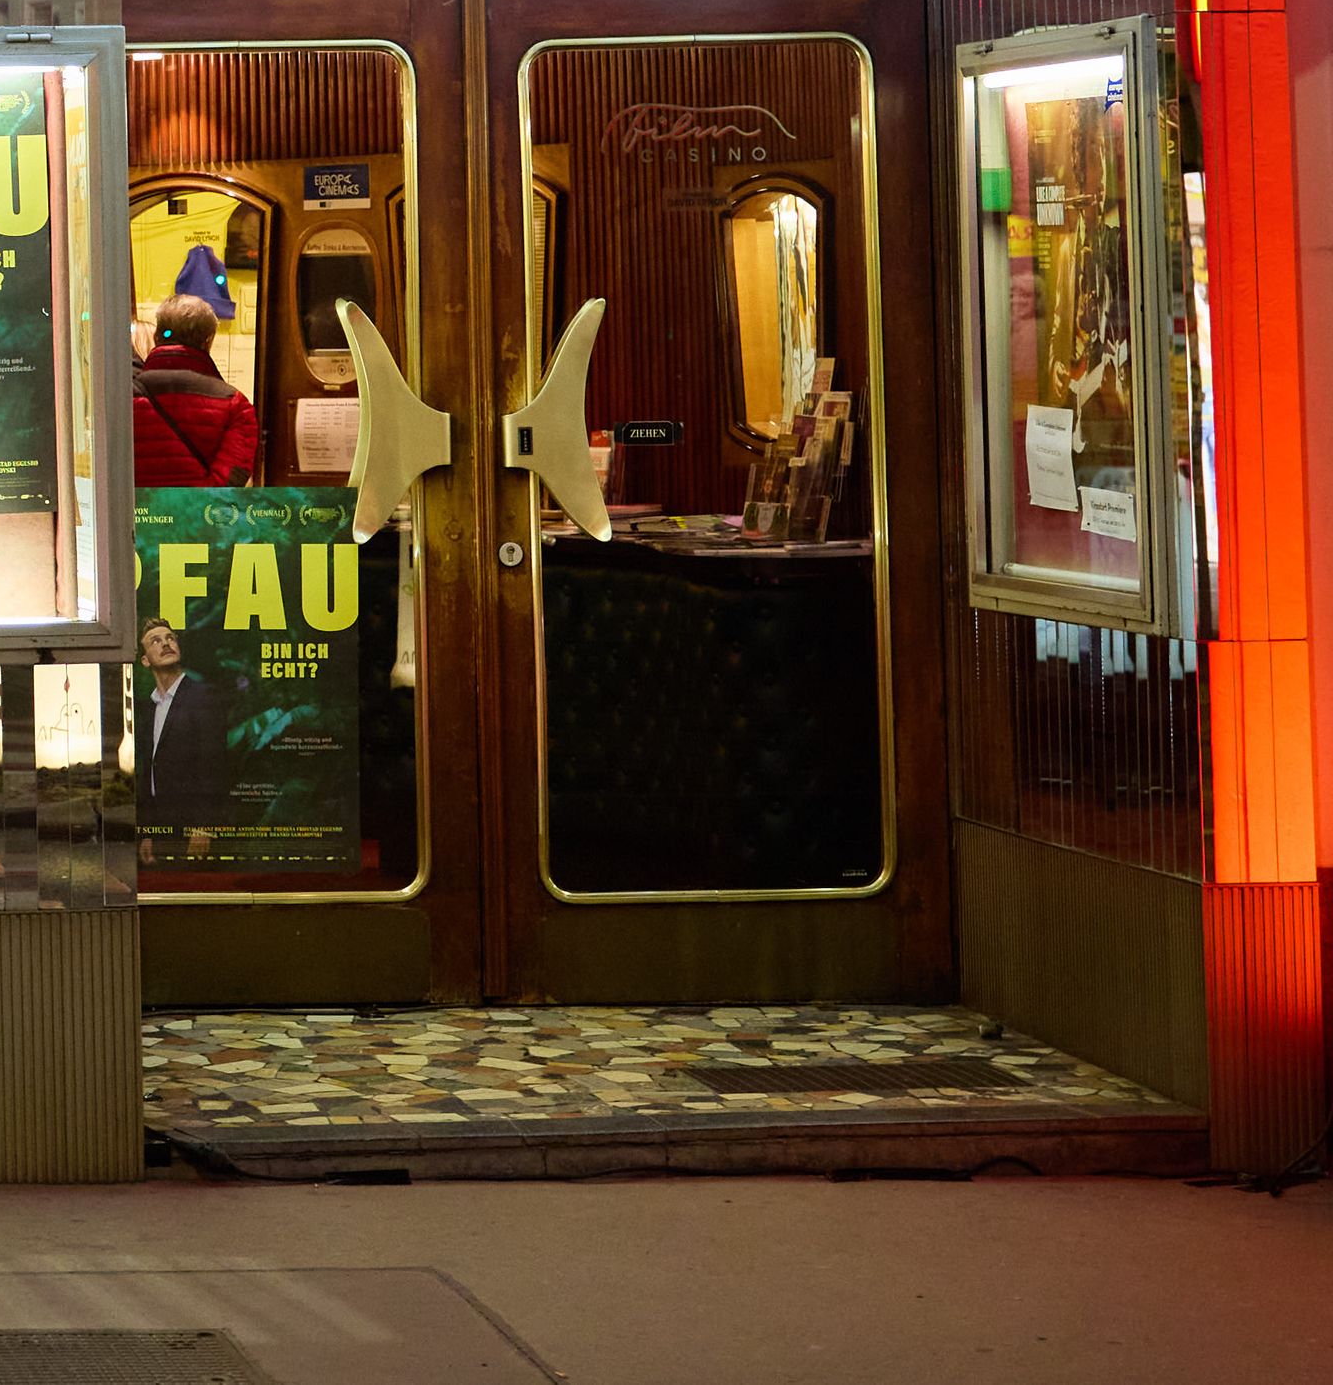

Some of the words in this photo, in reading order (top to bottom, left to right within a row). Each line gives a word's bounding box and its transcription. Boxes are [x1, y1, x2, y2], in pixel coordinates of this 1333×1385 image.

[640, 146, 767, 163] CASINO
[314, 174, 353, 186] EUROPA
[318, 184, 360, 196] CINEMAS
[630, 428, 667, 439] ZIEHEN
[134, 507, 149, 516] VON
[252, 509, 286, 518] VIENNALE
[142, 516, 174, 524] WENGER
[135, 543, 360, 632] FAU
[261, 643, 292, 659] BIN
[298, 643, 329, 659] ICH
[261, 662, 319, 679] ECHT?
[142, 826, 174, 834] SCHUCH
